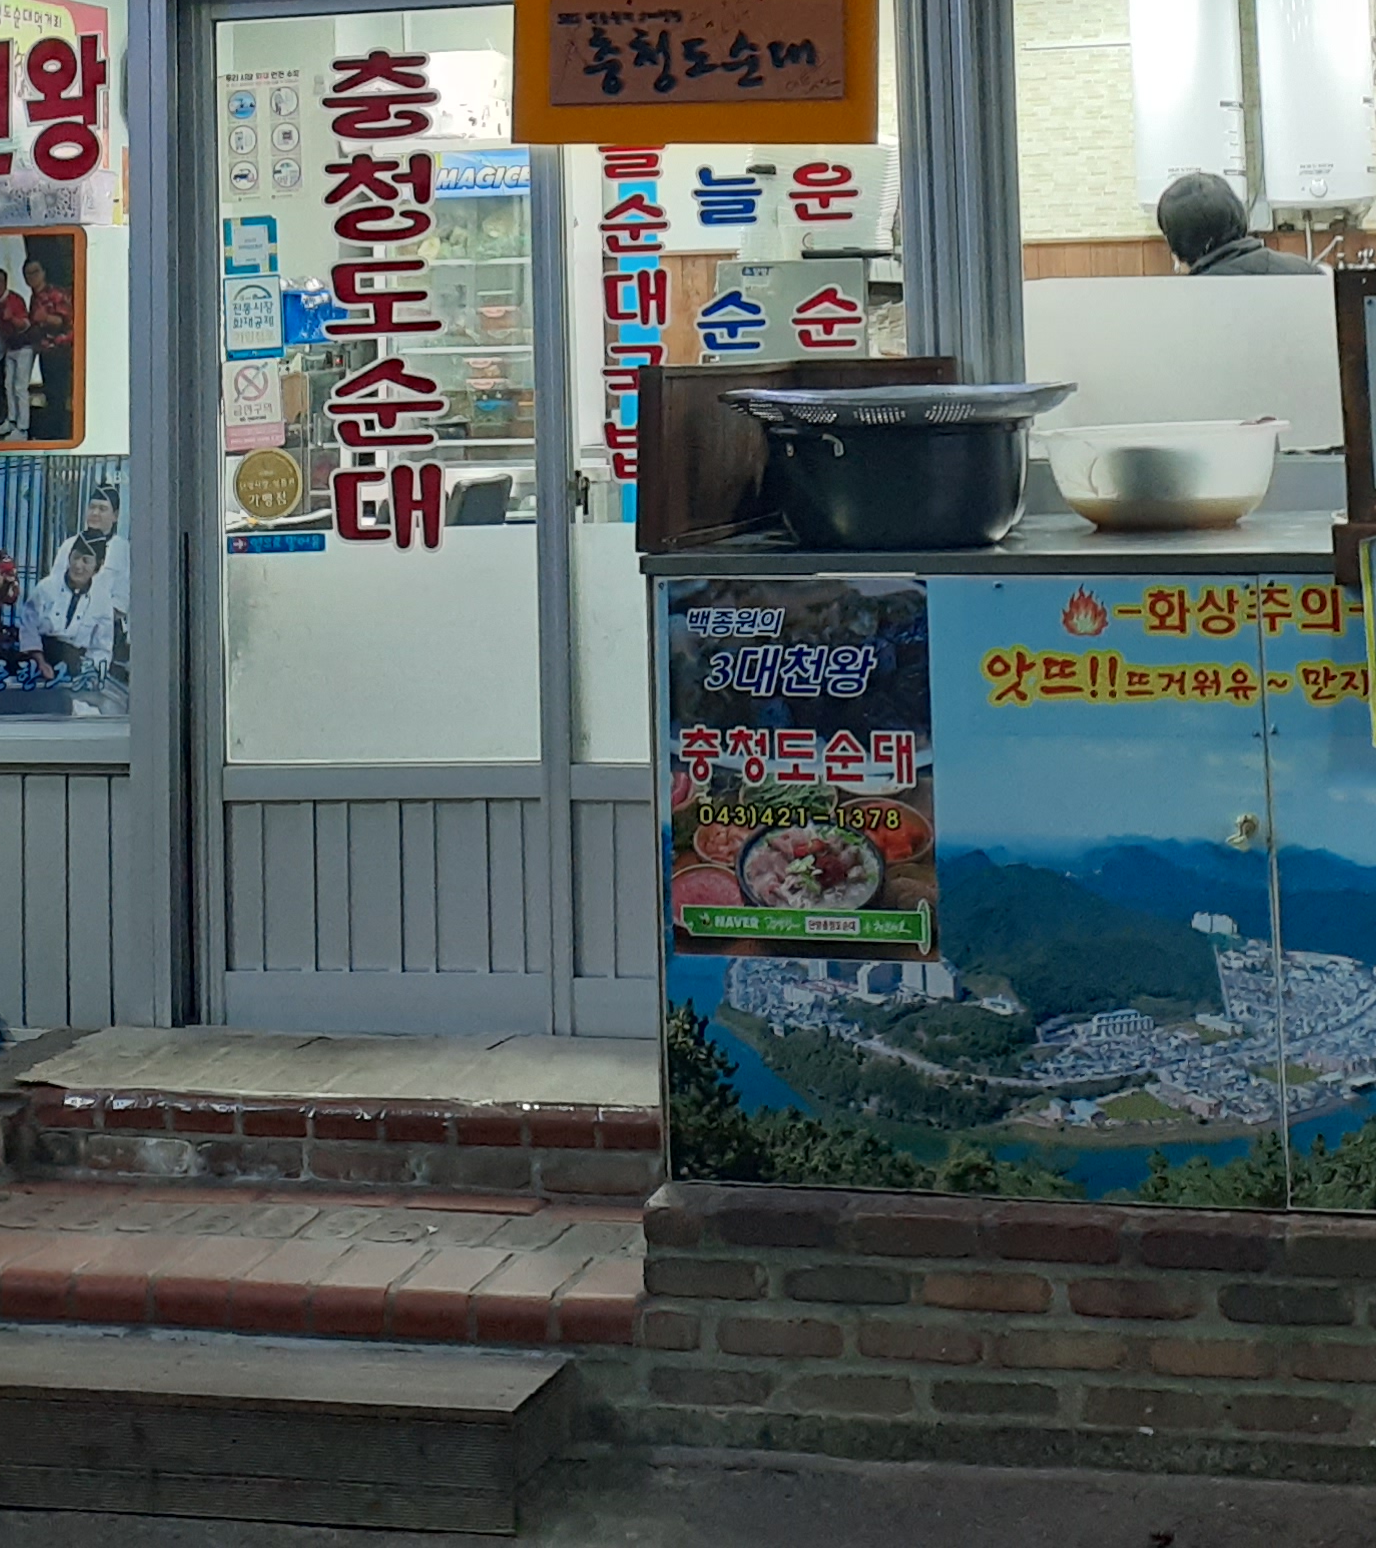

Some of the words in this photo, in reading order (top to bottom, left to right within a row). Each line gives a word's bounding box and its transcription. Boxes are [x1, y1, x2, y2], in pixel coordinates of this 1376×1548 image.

[322, 49, 448, 551] 충청도순대
[687, 608, 786, 638] 백종원의
[705, 645, 878, 698] 3대천왕
[679, 726, 917, 788] 충청도순대
[715, 916, 759, 930] NAVER
